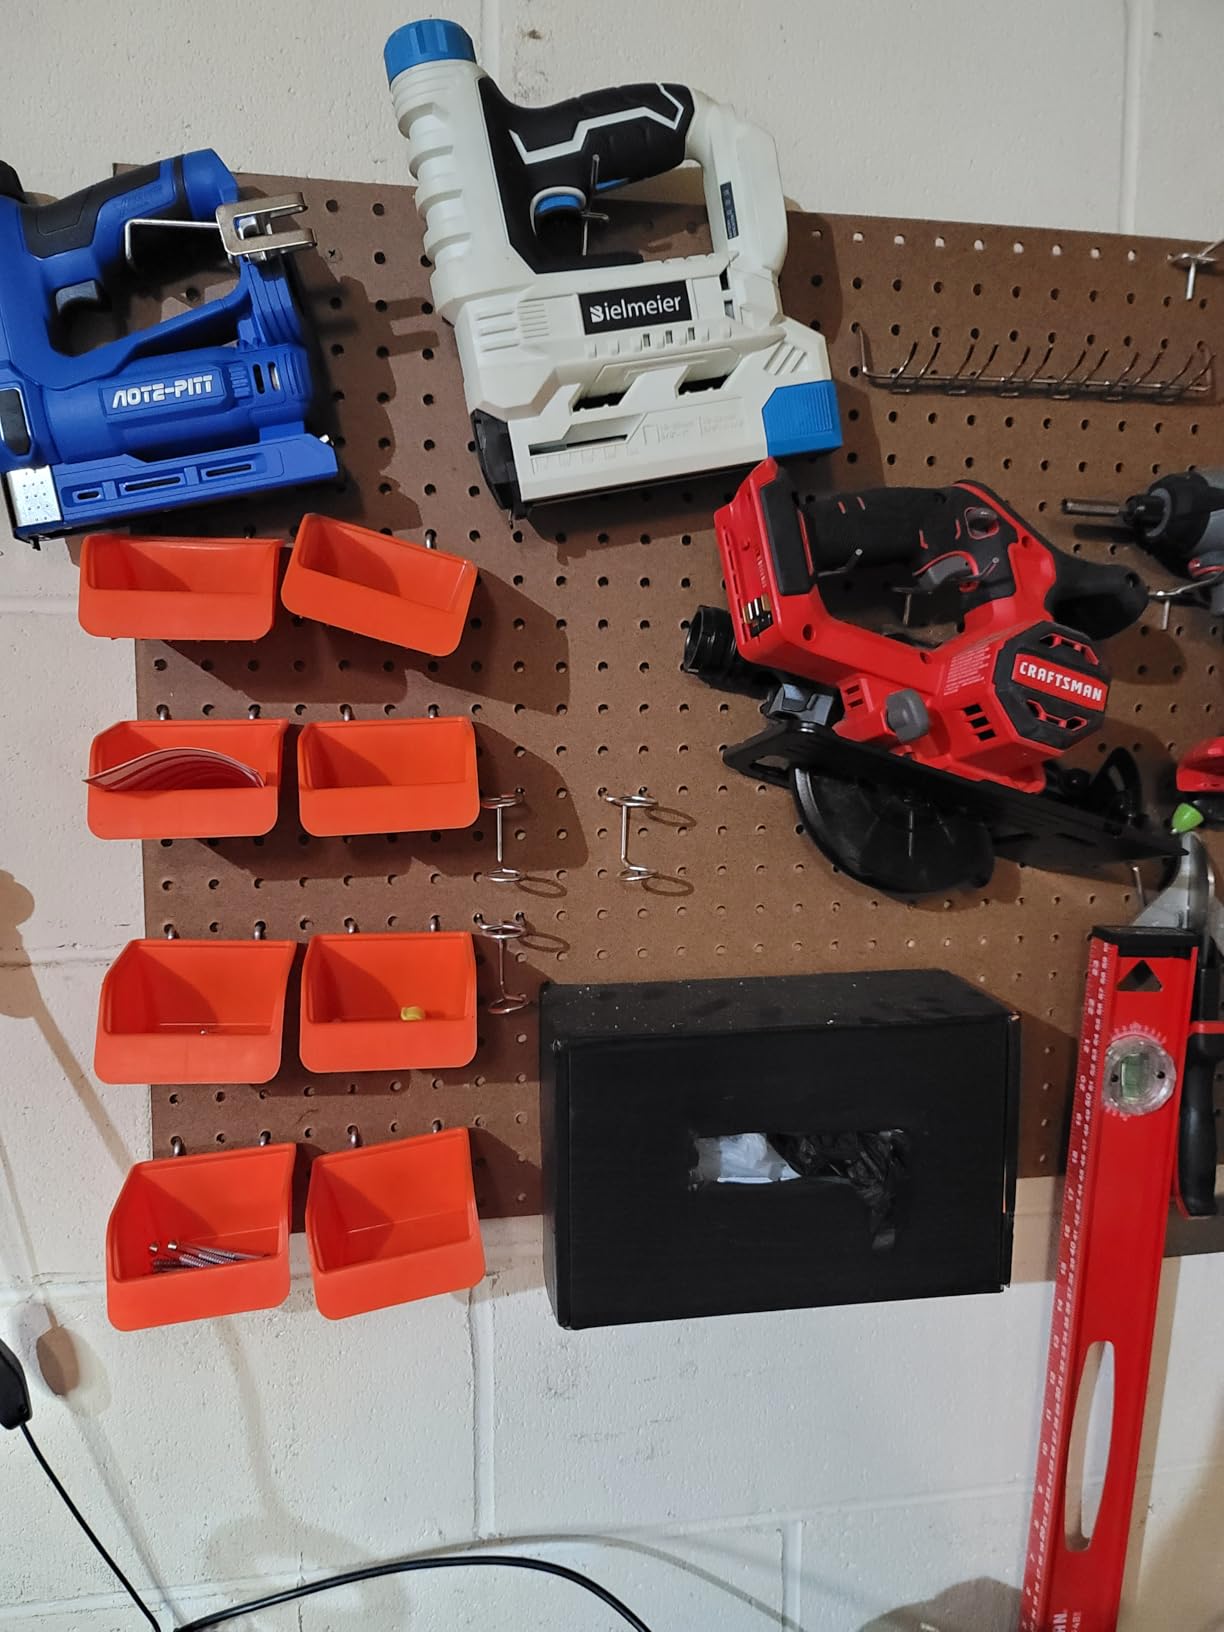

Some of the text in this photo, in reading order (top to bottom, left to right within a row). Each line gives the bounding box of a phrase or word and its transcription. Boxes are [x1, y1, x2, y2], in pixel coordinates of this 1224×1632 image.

[589, 294, 681, 323] Bielmeier
[112, 374, 213, 409] AOTE-PITT
[1019, 661, 1103, 702] CRAFTSMAN
